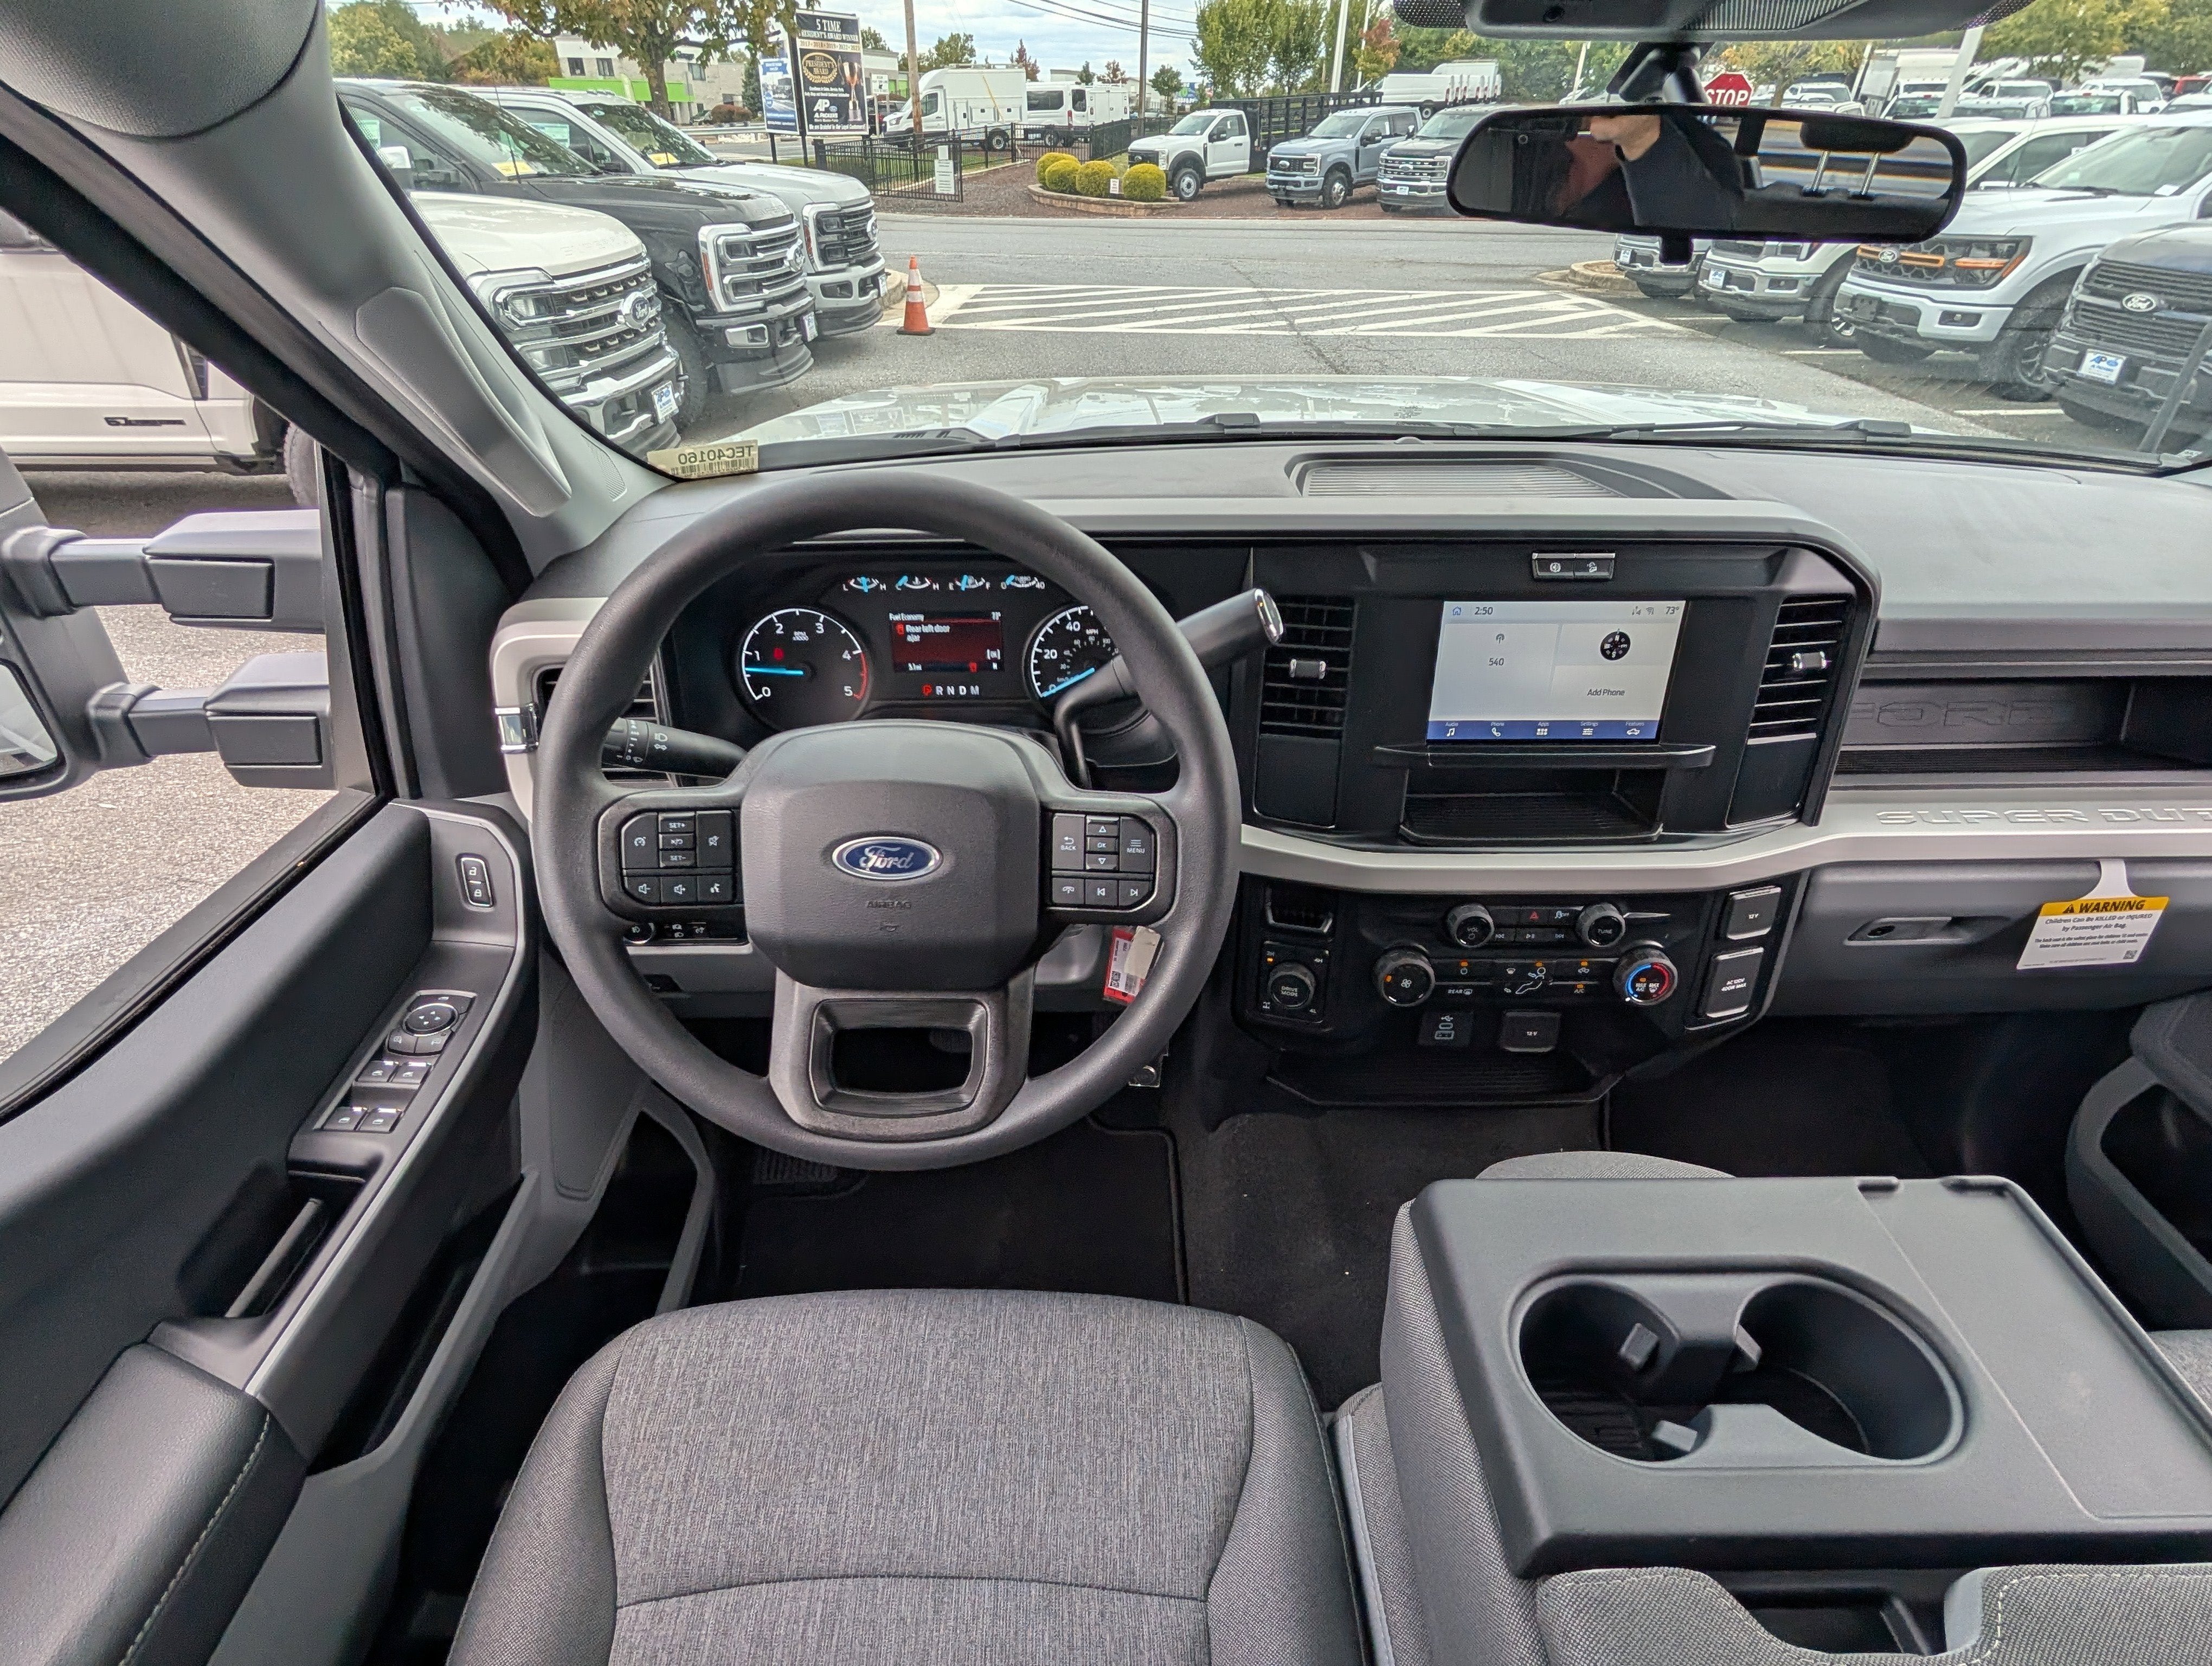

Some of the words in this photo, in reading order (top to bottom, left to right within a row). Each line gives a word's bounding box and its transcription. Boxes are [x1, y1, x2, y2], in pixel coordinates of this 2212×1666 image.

[816, 18, 821, 30] 5
[822, 19, 841, 33] TIME
[1706, 88, 1749, 105] STOP
[813, 99, 830, 112] AP
[1474, 606, 1494, 615] 2:50
[1666, 606, 1680, 615] 73°
[889, 613, 901, 621] Fuel
[901, 613, 924, 622] Economy
[775, 623, 784, 634] 2
[815, 624, 824, 634] 3
[905, 624, 922, 633] Rear
[934, 624, 950, 632] door
[1065, 621, 1081, 631] 40
[906, 634, 921, 643] ajar
[754, 651, 760, 661] 1
[842, 650, 851, 661] 4
[1043, 649, 1057, 659] 20
[1488, 657, 1504, 667] 540
[761, 686, 771, 697] 0
[844, 685, 853, 697] 5
[923, 683, 933, 696] P
[935, 685, 943, 695] R
[946, 685, 955, 695] N
[959, 685, 967, 695] D
[970, 685, 980, 695] M
[1587, 688, 1602, 696] Add
[1603, 688, 1625, 696] Phone
[1875, 809, 2089, 824] SUPER
[859, 845, 915, 872] Ford
[2079, 900, 2146, 913] WARNING
